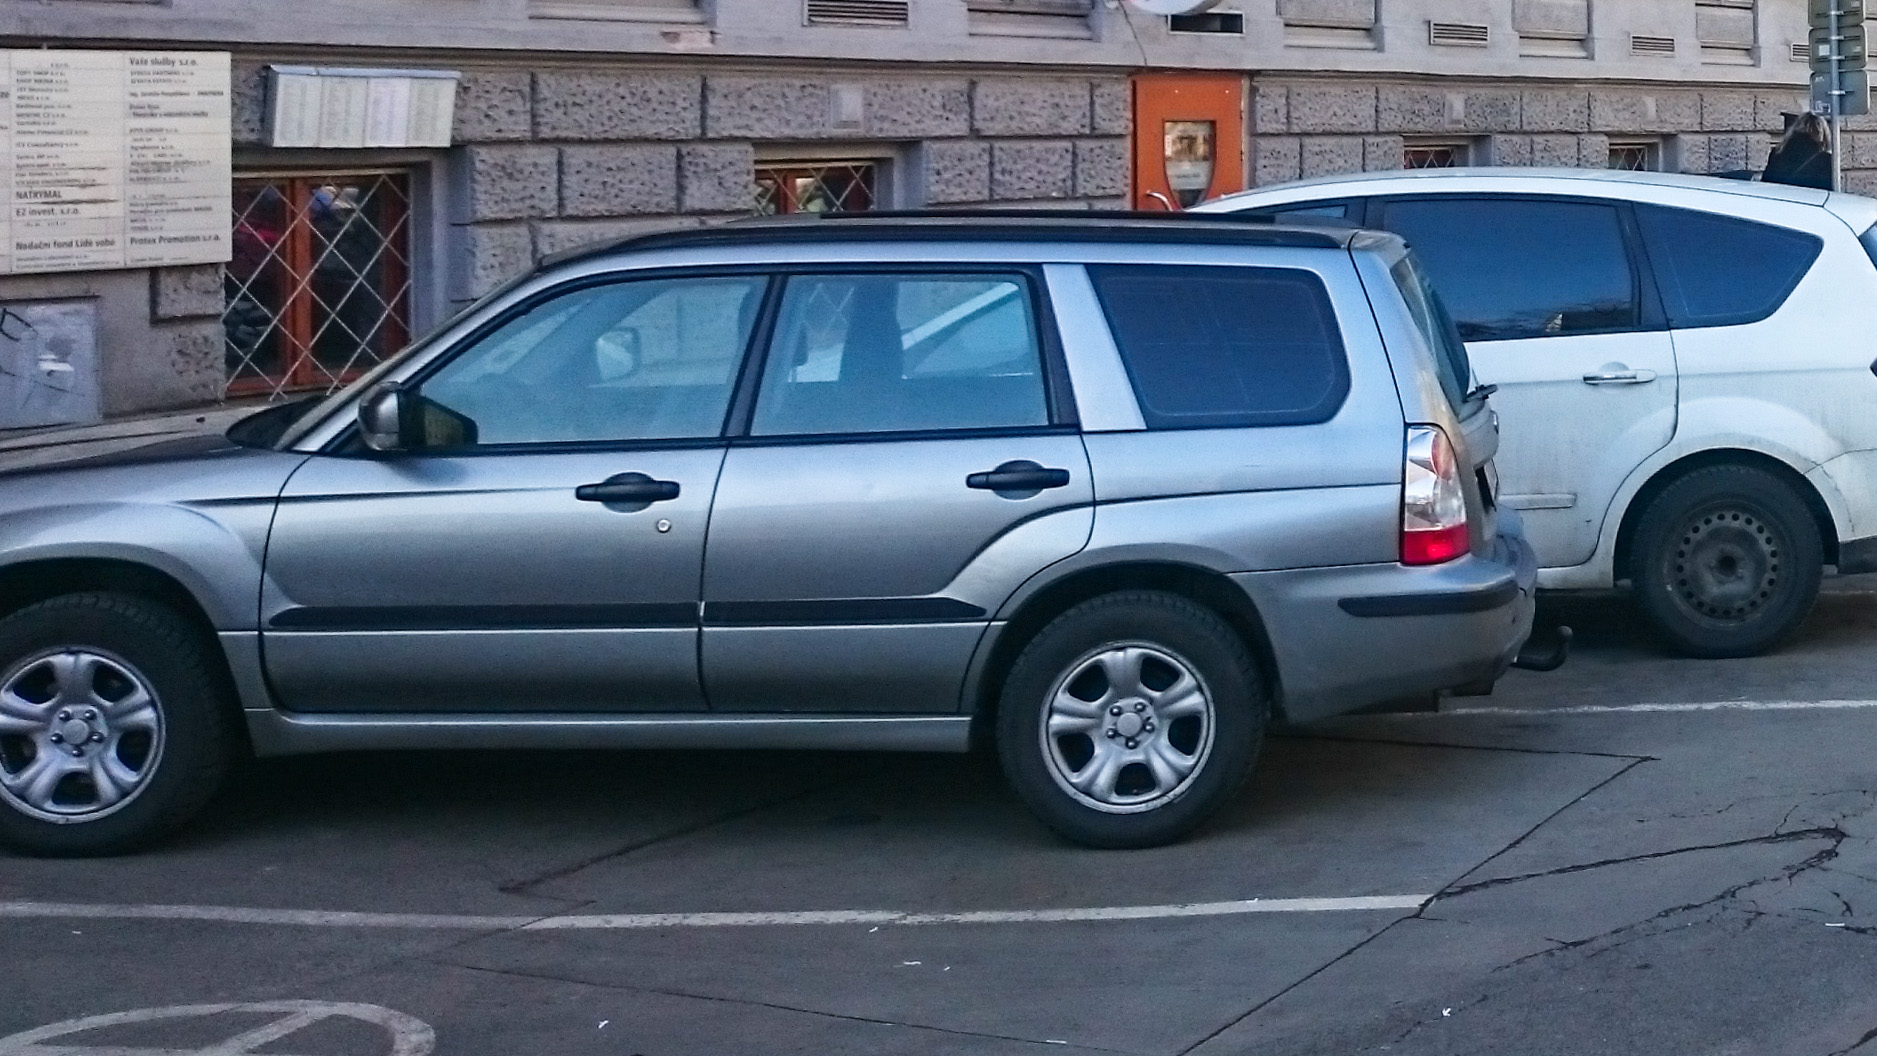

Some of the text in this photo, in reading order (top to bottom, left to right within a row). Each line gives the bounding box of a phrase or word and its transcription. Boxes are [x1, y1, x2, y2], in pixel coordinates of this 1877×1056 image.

[130, 57, 148, 66] Vaše
[53, 239, 73, 248] fond
[158, 234, 200, 244] Promotion
